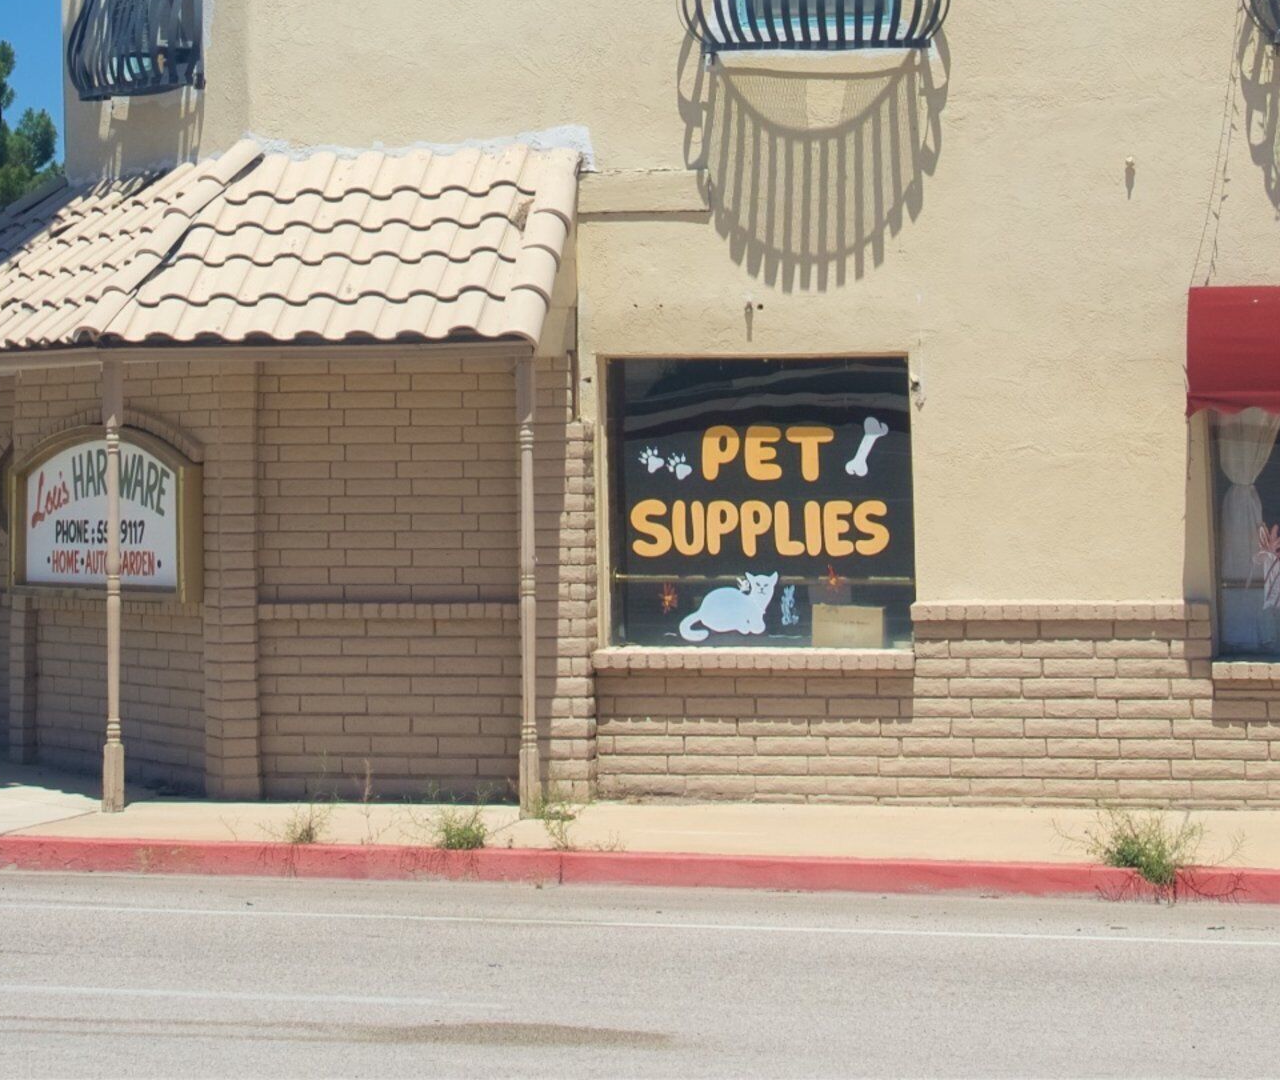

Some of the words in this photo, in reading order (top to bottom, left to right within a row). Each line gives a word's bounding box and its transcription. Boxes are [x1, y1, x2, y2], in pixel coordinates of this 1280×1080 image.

[72, 448, 170, 516] HARWARE
[701, 424, 834, 482] PET
[630, 499, 890, 558] SUPPLIES
[52, 550, 80, 574] HOME
